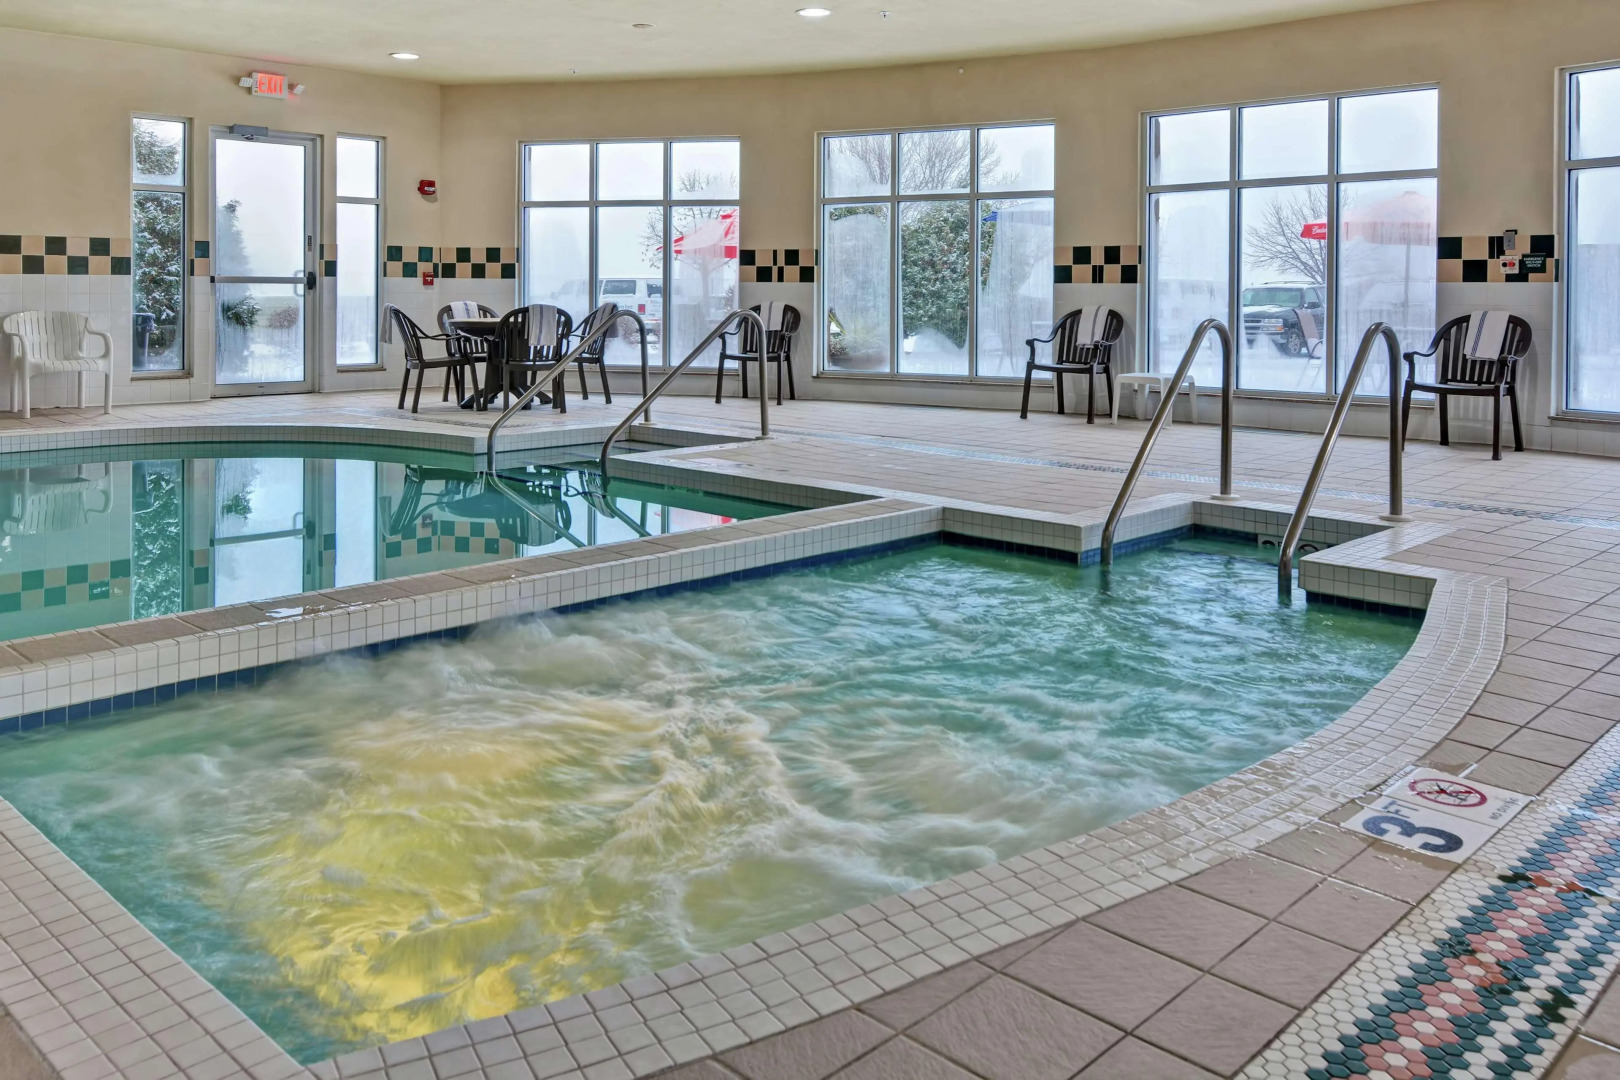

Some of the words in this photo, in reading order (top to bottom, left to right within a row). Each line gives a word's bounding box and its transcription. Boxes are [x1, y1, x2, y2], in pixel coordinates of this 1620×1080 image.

[258, 73, 284, 95] EXIT
[1382, 800, 1419, 819] FT
[1488, 811, 1503, 820] NO
[1362, 815, 1463, 853] 3
